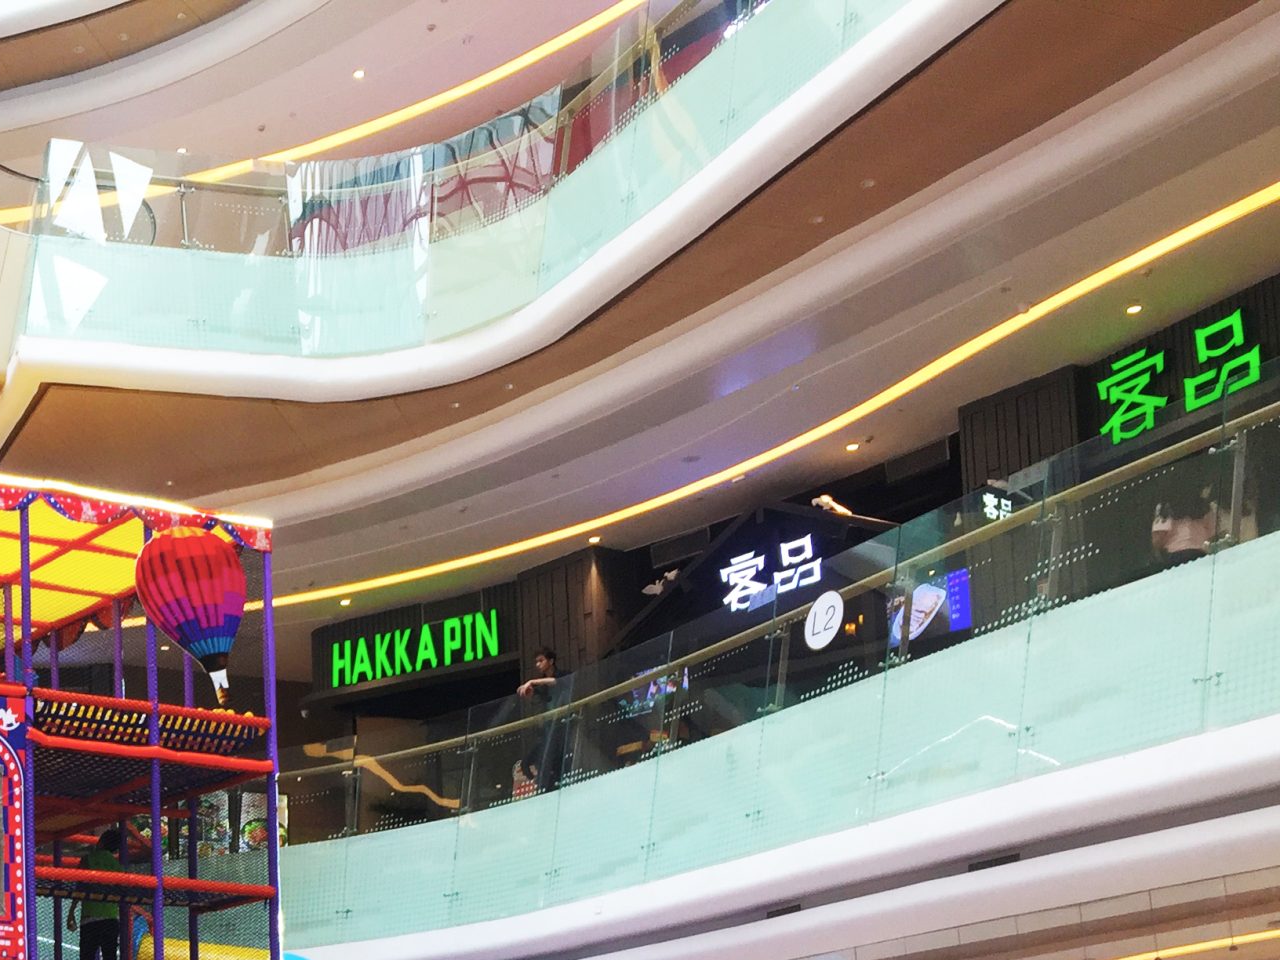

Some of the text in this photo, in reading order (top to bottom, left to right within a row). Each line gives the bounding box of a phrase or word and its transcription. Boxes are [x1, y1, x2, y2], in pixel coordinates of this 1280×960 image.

[1096, 308, 1261, 445] 客品
[719, 533, 823, 612] 客品
[331, 608, 499, 688] HAKKA PIN
[811, 604, 837, 637] L2
